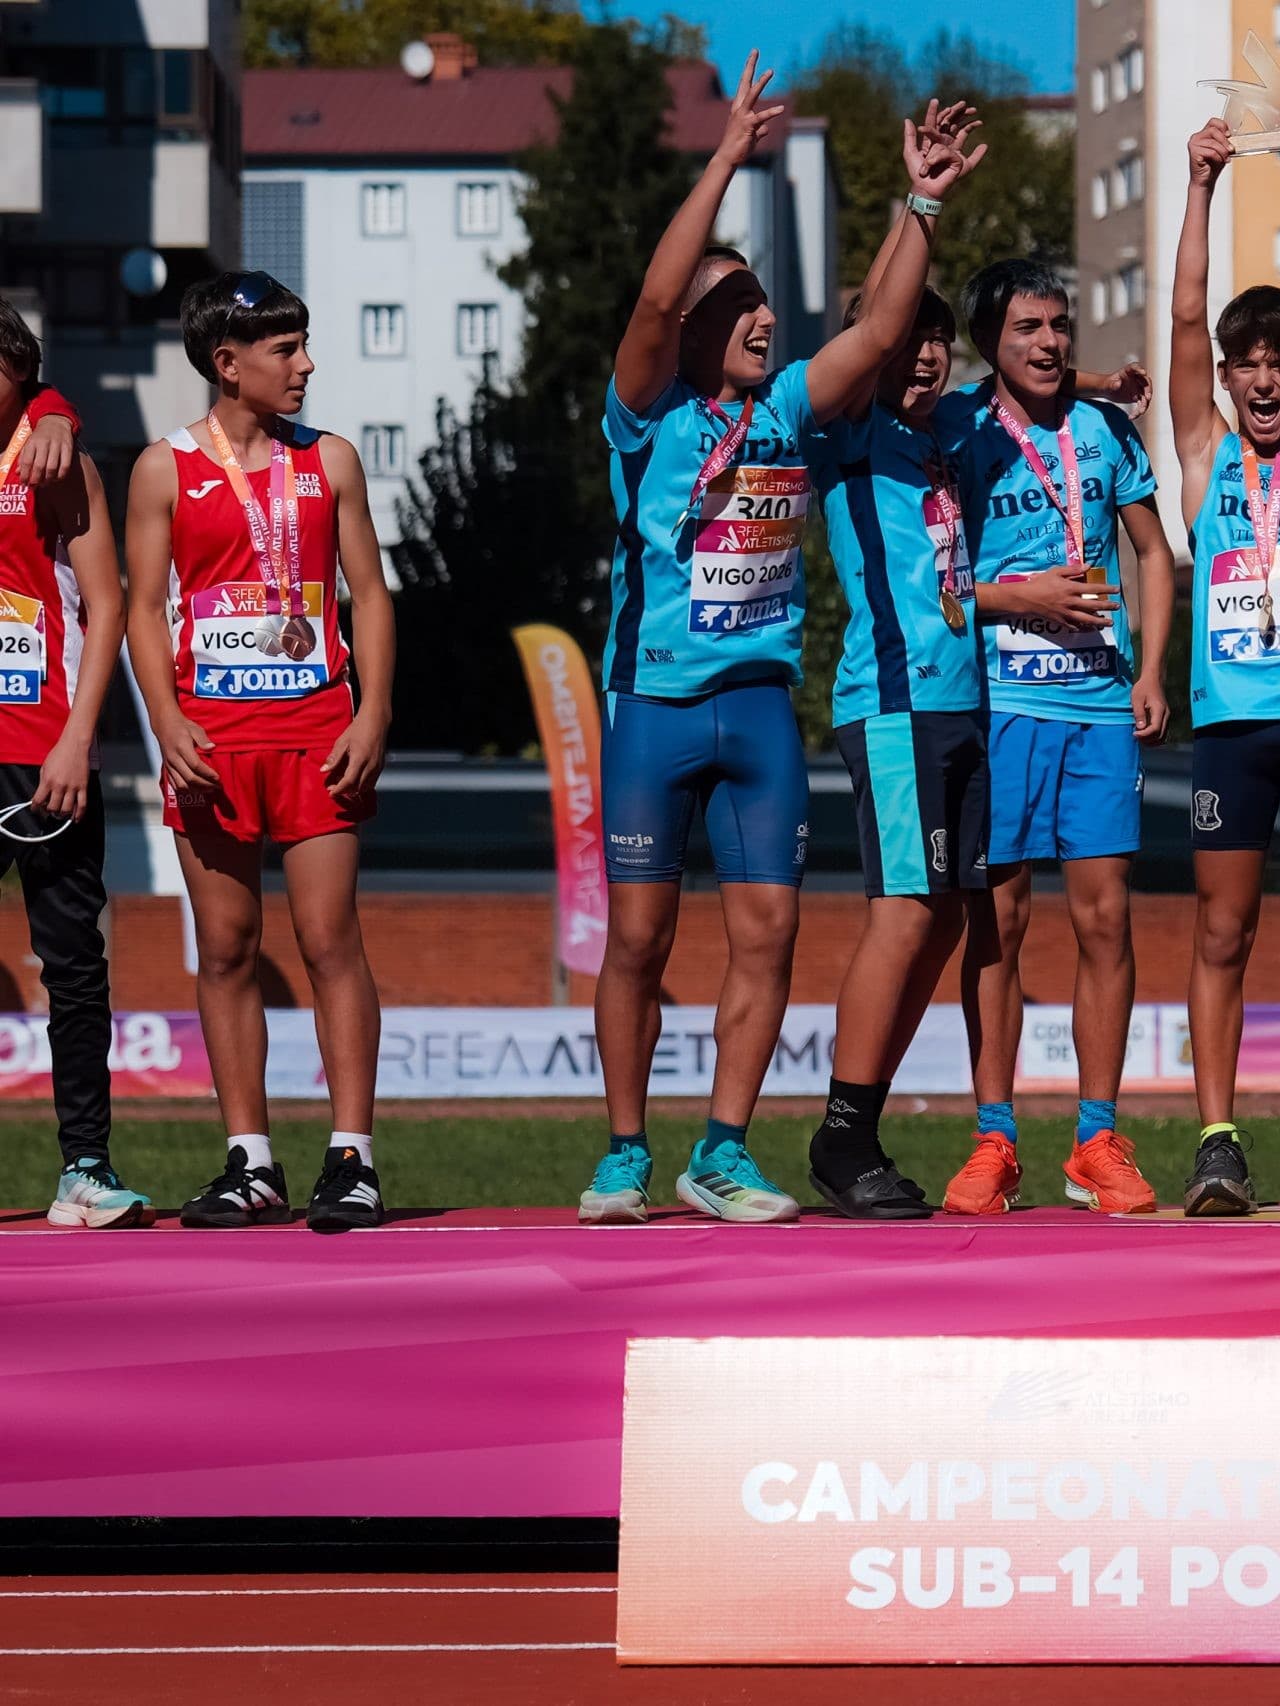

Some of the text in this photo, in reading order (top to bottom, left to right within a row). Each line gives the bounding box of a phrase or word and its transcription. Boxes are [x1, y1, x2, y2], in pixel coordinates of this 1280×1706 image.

[751, 481, 805, 492] ATLETISMO
[989, 474, 1105, 520] nera
[1068, 469, 1081, 522] ATLETISMO
[271, 497, 283, 552] ATLETISMO
[737, 496, 791, 519] 340
[286, 500, 299, 554] ATLETISMO
[742, 533, 796, 549] ATLETISMO
[702, 561, 793, 586] VIGO 2026
[611, 834, 654, 848] nerja
[380, 1031, 528, 1081] RFEA
[1084, 1392, 1190, 1407] ATLETISMO
[846, 1546, 1144, 1610] SUB-14
